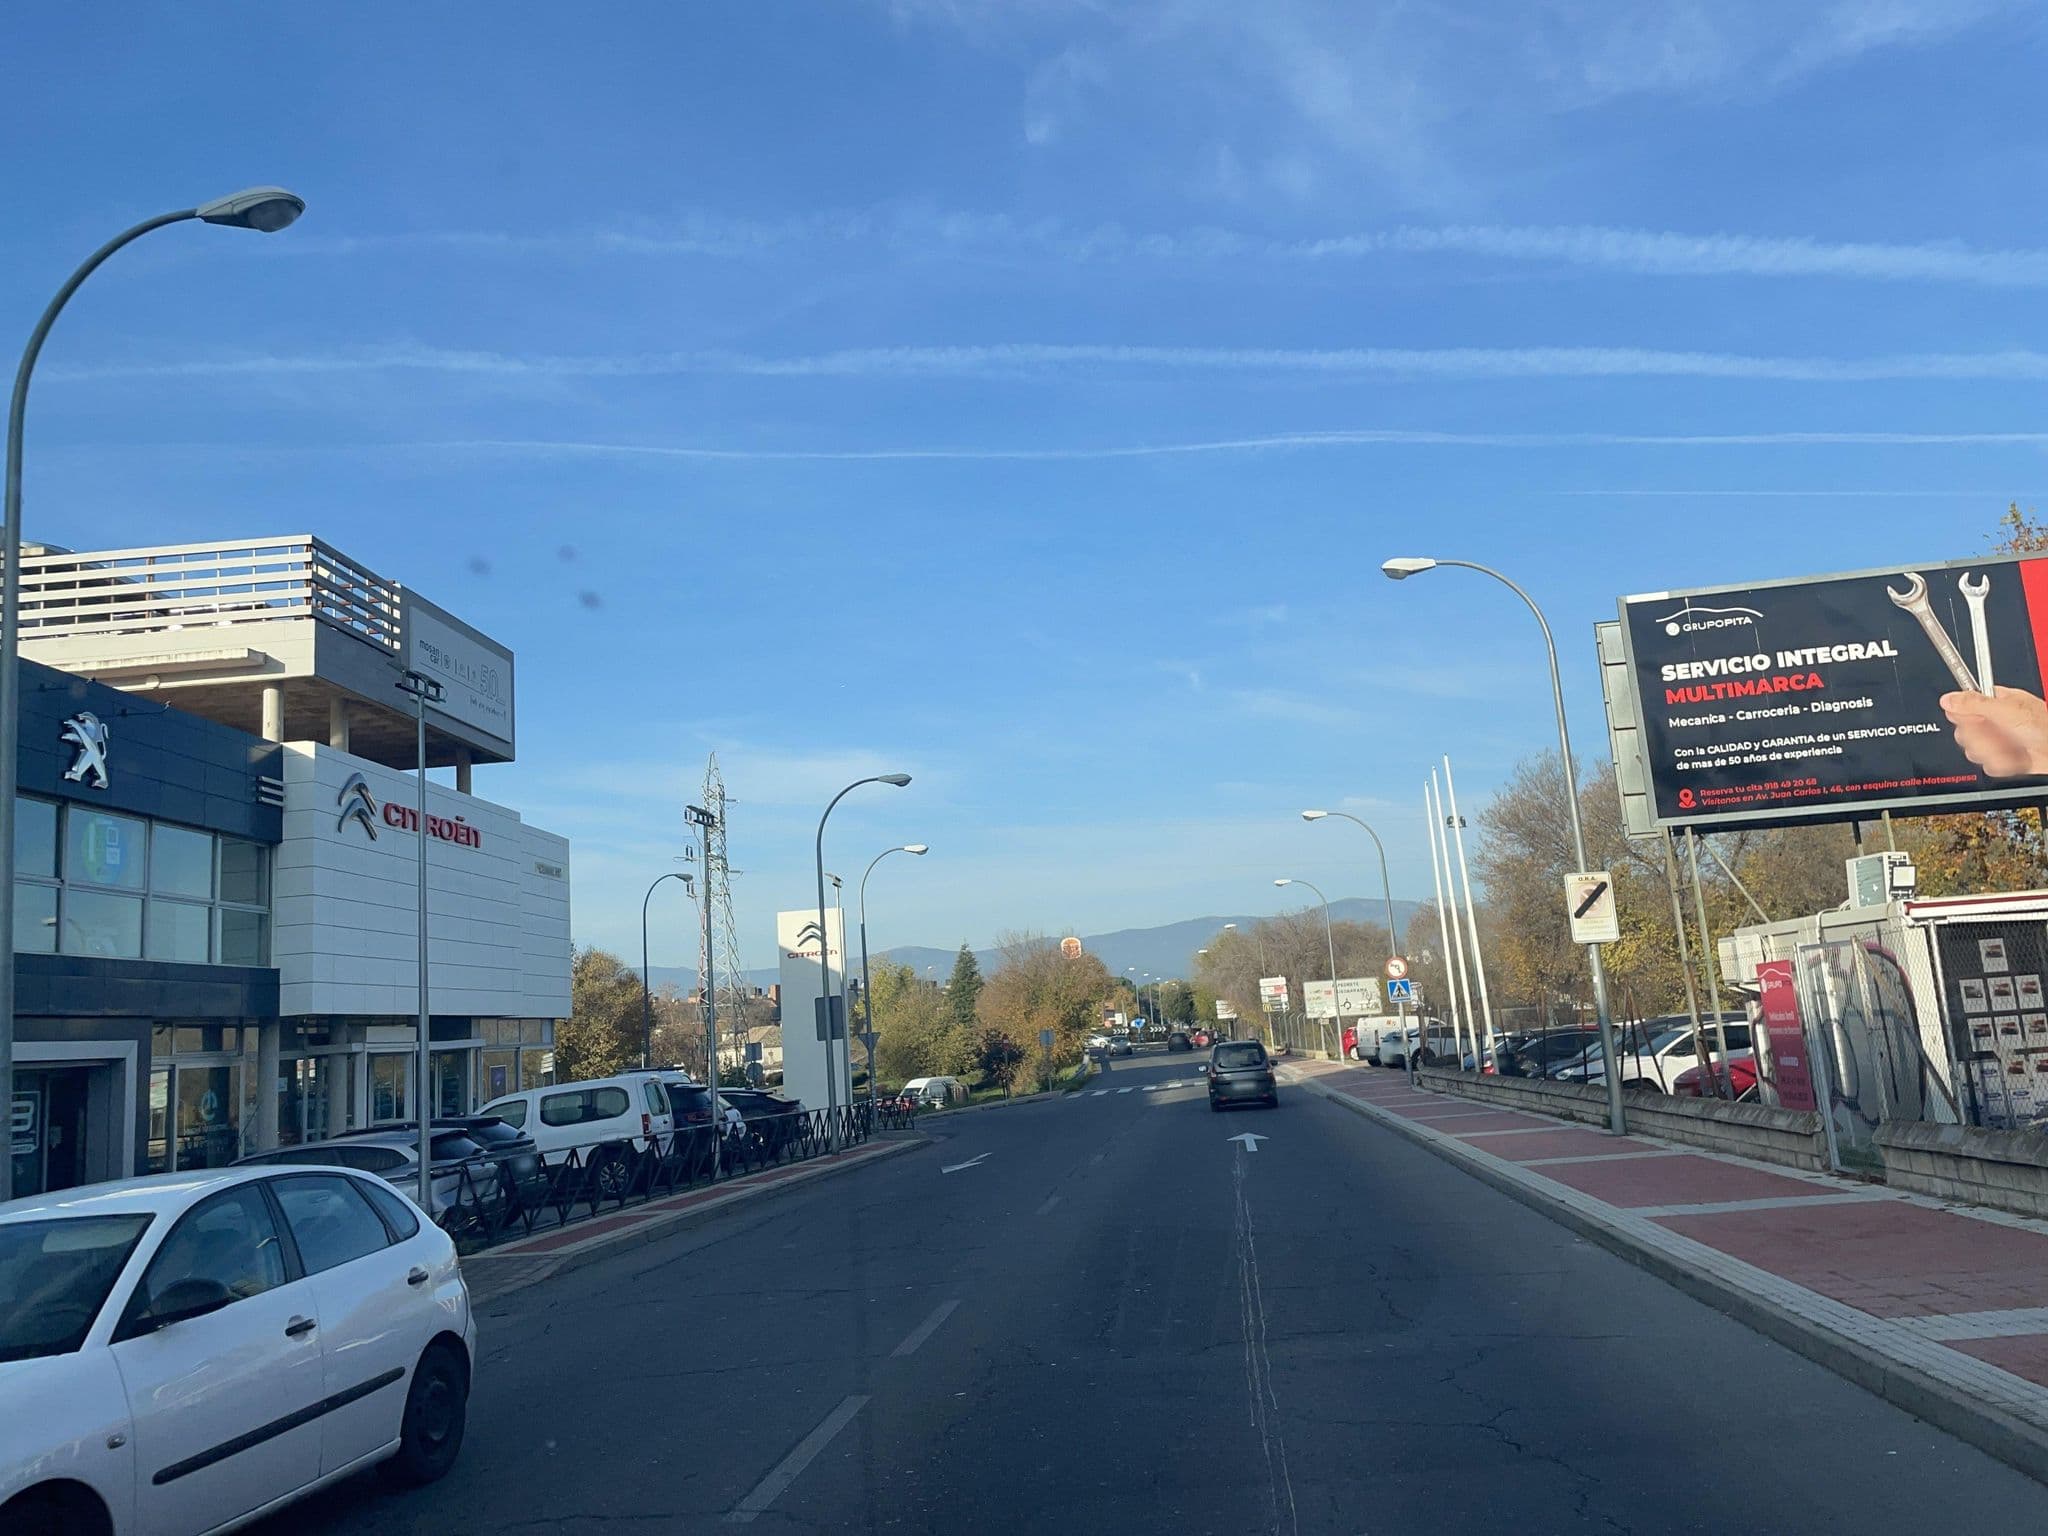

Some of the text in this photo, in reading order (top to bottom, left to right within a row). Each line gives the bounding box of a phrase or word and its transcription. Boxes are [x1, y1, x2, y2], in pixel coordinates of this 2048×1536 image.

[1682, 616, 1752, 632] GRUPOPITA
[1661, 640, 1898, 682] SERVICIO INTEGRAL
[1665, 672, 1824, 705] MULTIMARCA
[1668, 713, 1726, 728] Mecanica
[1736, 703, 1800, 720] Carroceria
[1811, 696, 1873, 713] Diagnosis
[1674, 723, 1940, 757] Con la CALIDAD y GARANTIA de un SERVICIO OFICIAL
[1676, 745, 1843, 770] de mas de 50 años de experiencia
[1700, 786, 1734, 797] Reserva
[1735, 785, 1745, 793] tu
[1747, 783, 1762, 791] cita
[1793, 779, 1804, 787] 20
[1770, 790, 1792, 800] Juan
[1793, 786, 1821, 797] Carlos
[1845, 784, 1861, 792] con
[1863, 780, 1898, 791] esquina
[1900, 777, 1921, 788] calle
[384, 802, 481, 848] CITROËN
[787, 950, 838, 959] CITRON
